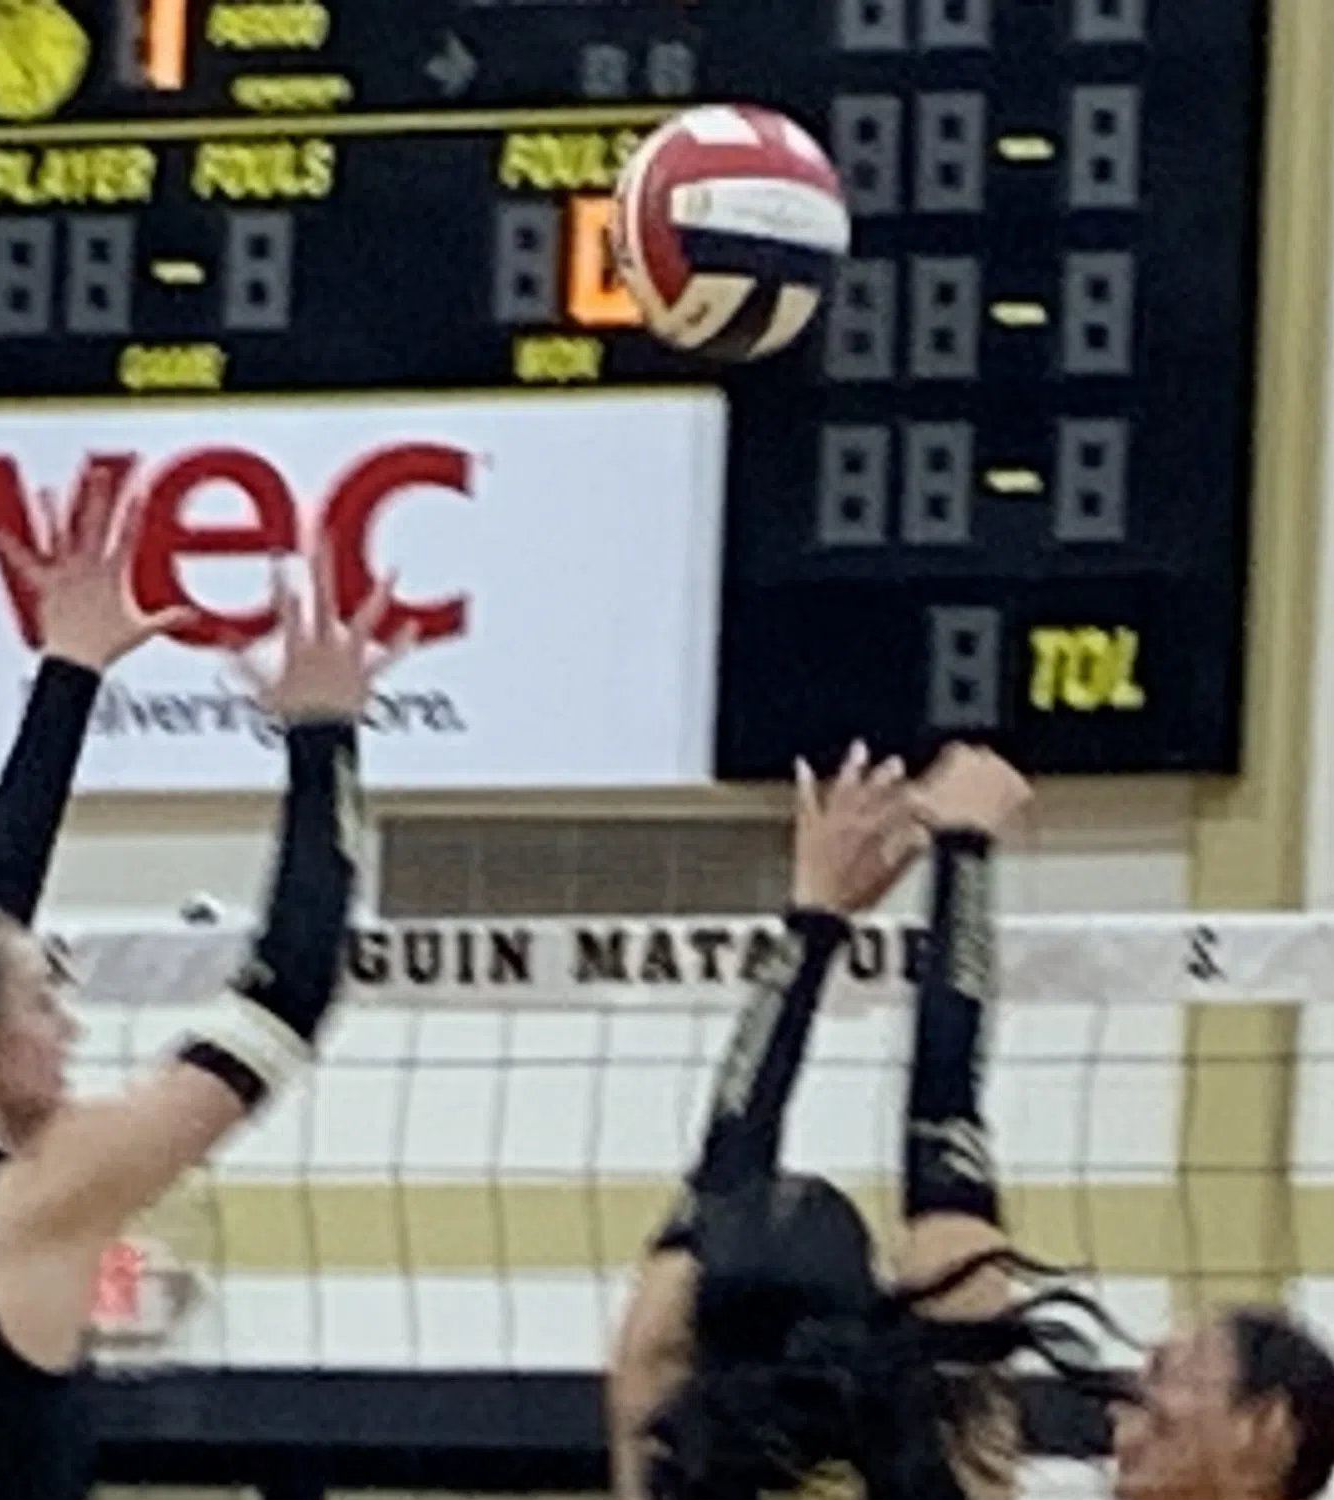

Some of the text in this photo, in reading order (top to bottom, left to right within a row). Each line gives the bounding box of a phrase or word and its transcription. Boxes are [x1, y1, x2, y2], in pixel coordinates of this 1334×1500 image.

[192, 140, 335, 199] FOULS
[1029, 624, 1146, 711] TOL
[346, 924, 535, 985] GUIN
